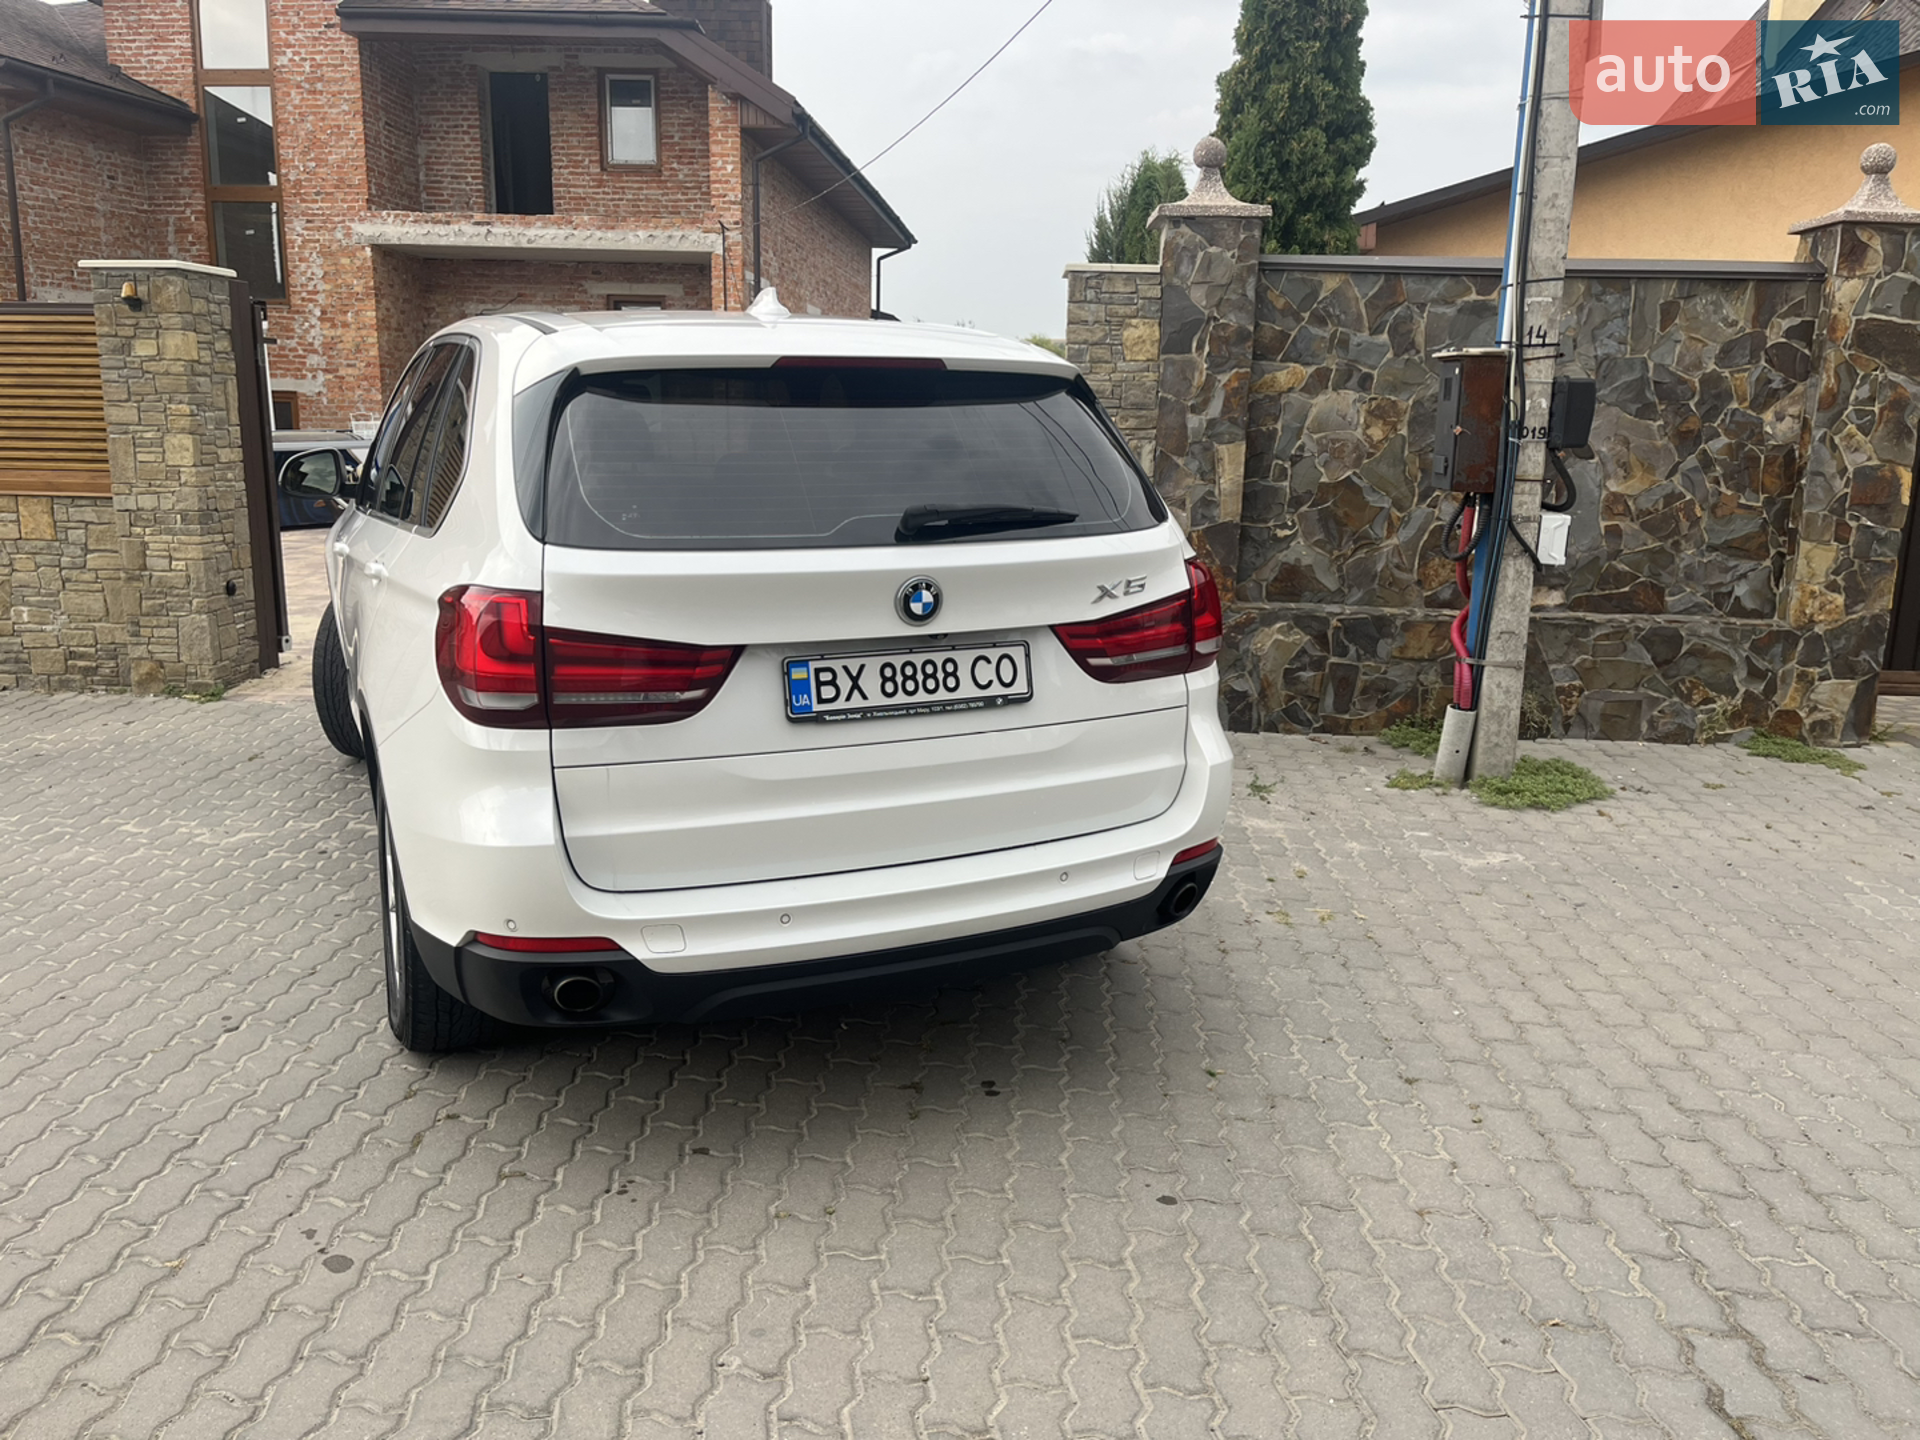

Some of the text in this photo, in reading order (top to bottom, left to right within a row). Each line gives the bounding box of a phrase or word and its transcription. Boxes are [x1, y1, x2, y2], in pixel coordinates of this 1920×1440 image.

[1527, 324, 1547, 348] 14
[1090, 574, 1147, 605] X5
[814, 653, 1018, 705] BX 8888 CO
[792, 693, 811, 707] UA
